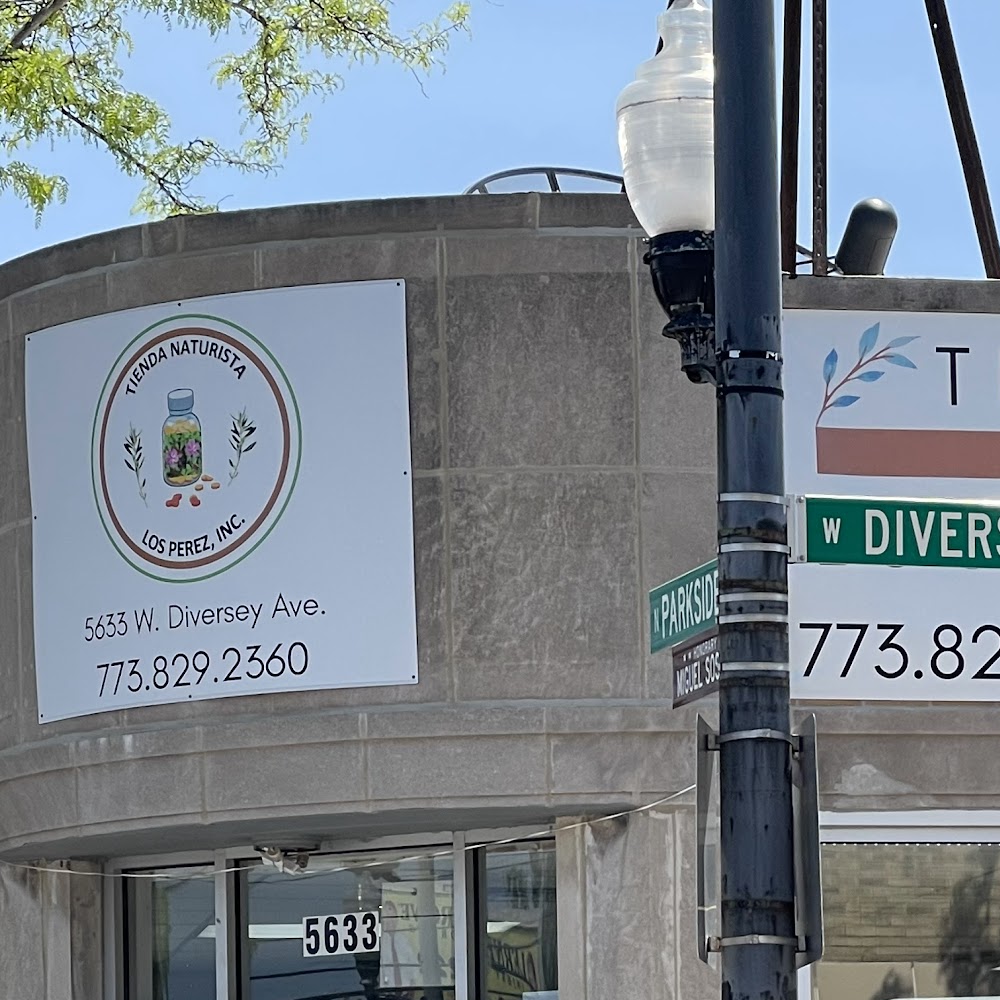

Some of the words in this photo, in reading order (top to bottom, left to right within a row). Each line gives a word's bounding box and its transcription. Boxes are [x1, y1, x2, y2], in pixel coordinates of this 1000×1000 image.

[126, 347, 168, 395] TIENDA
[170, 339, 247, 380] NATURISTA
[142, 529, 166, 554] LOS
[168, 534, 215, 557] PEREZ,
[216, 513, 246, 543] INC.
[822, 517, 842, 545] W
[84, 611, 128, 642] 5633
[134, 607, 160, 634] W.
[168, 603, 264, 629] Diversey
[271, 592, 326, 620] Ave.
[653, 606, 660, 634] N
[96, 641, 310, 698] 773.829.2360
[676, 660, 703, 698] MIGUEL
[705, 651, 720, 685] SOS
[304, 912, 378, 955] 5633
